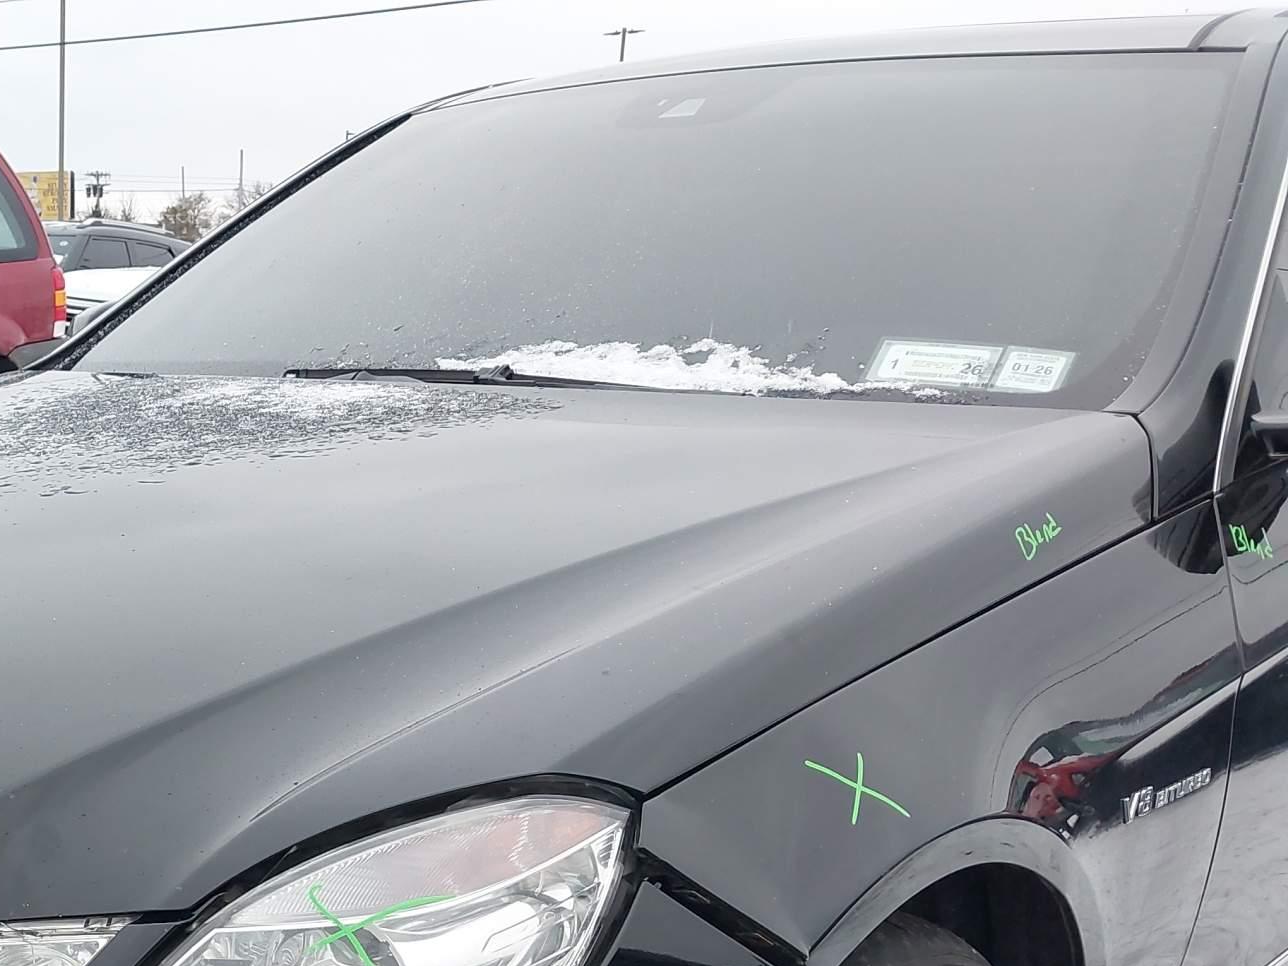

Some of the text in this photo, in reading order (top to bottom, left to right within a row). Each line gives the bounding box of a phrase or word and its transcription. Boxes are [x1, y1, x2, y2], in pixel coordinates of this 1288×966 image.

[1014, 511, 1064, 561] Blend
[1228, 522, 1274, 560] Blend
[1119, 767, 1212, 825] V8 BITURBO
